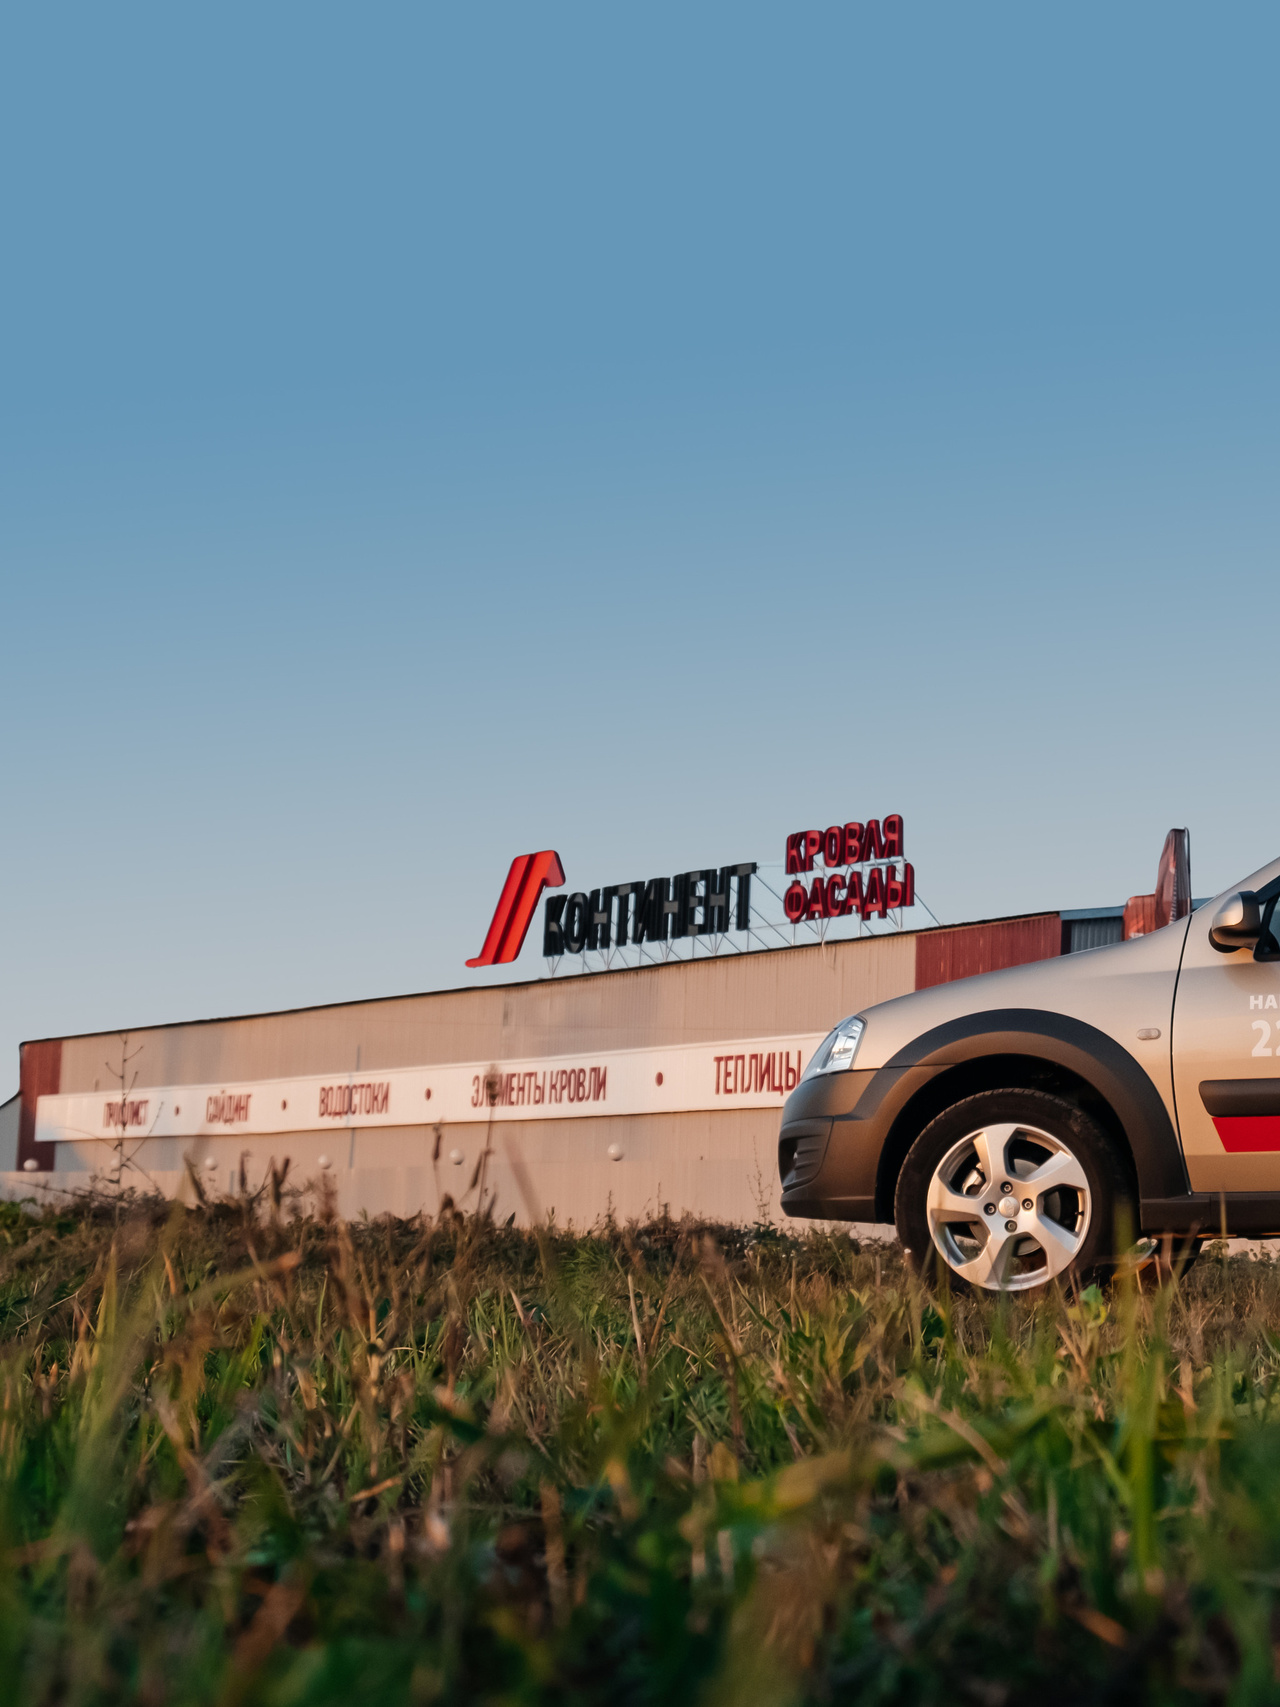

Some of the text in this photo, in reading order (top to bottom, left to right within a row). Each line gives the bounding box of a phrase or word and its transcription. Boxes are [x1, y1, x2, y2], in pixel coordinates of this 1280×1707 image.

[785, 814, 904, 875] КРОВЛЯ
[543, 862, 757, 957] КОНТИНЕНТ
[783, 863, 915, 924] ФАСАДЫ
[206, 1089, 252, 1125] САЙДИНГ
[318, 1082, 390, 1119] ВОДОСТОКИ
[549, 1066, 608, 1104] КРОВЛИ
[713, 1050, 802, 1096] ТЕПЛИЦЫ
